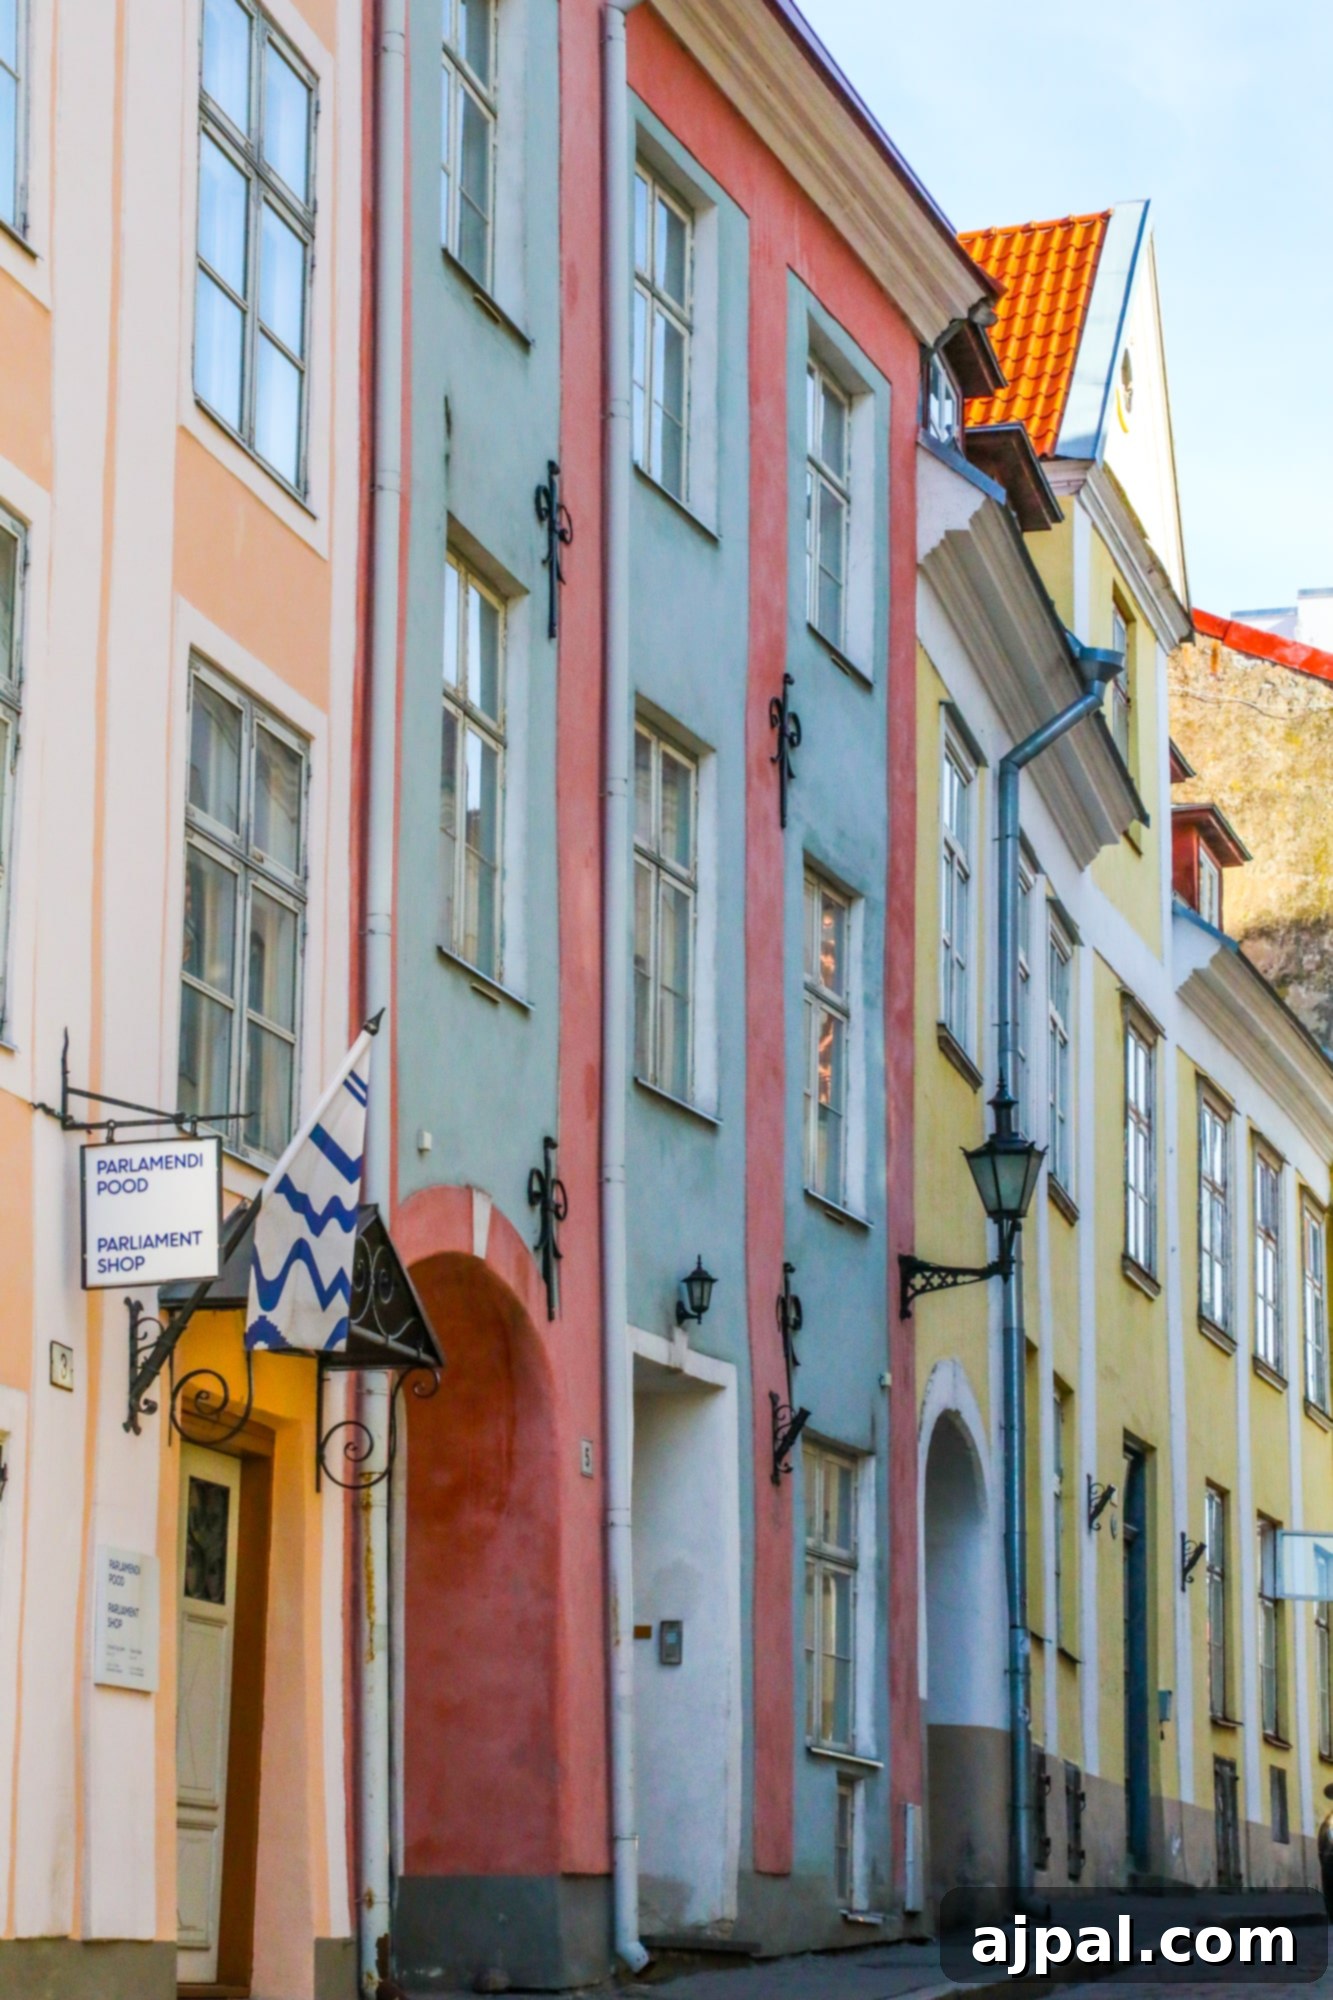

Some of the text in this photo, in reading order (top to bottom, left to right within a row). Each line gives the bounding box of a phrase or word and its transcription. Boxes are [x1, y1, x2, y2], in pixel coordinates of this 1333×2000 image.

[96, 1153, 203, 1175] PARLAMENDI
[97, 1177, 149, 1195] POOD
[97, 1230, 203, 1253] PARLIAMENT
[97, 1256, 146, 1274] SHOP
